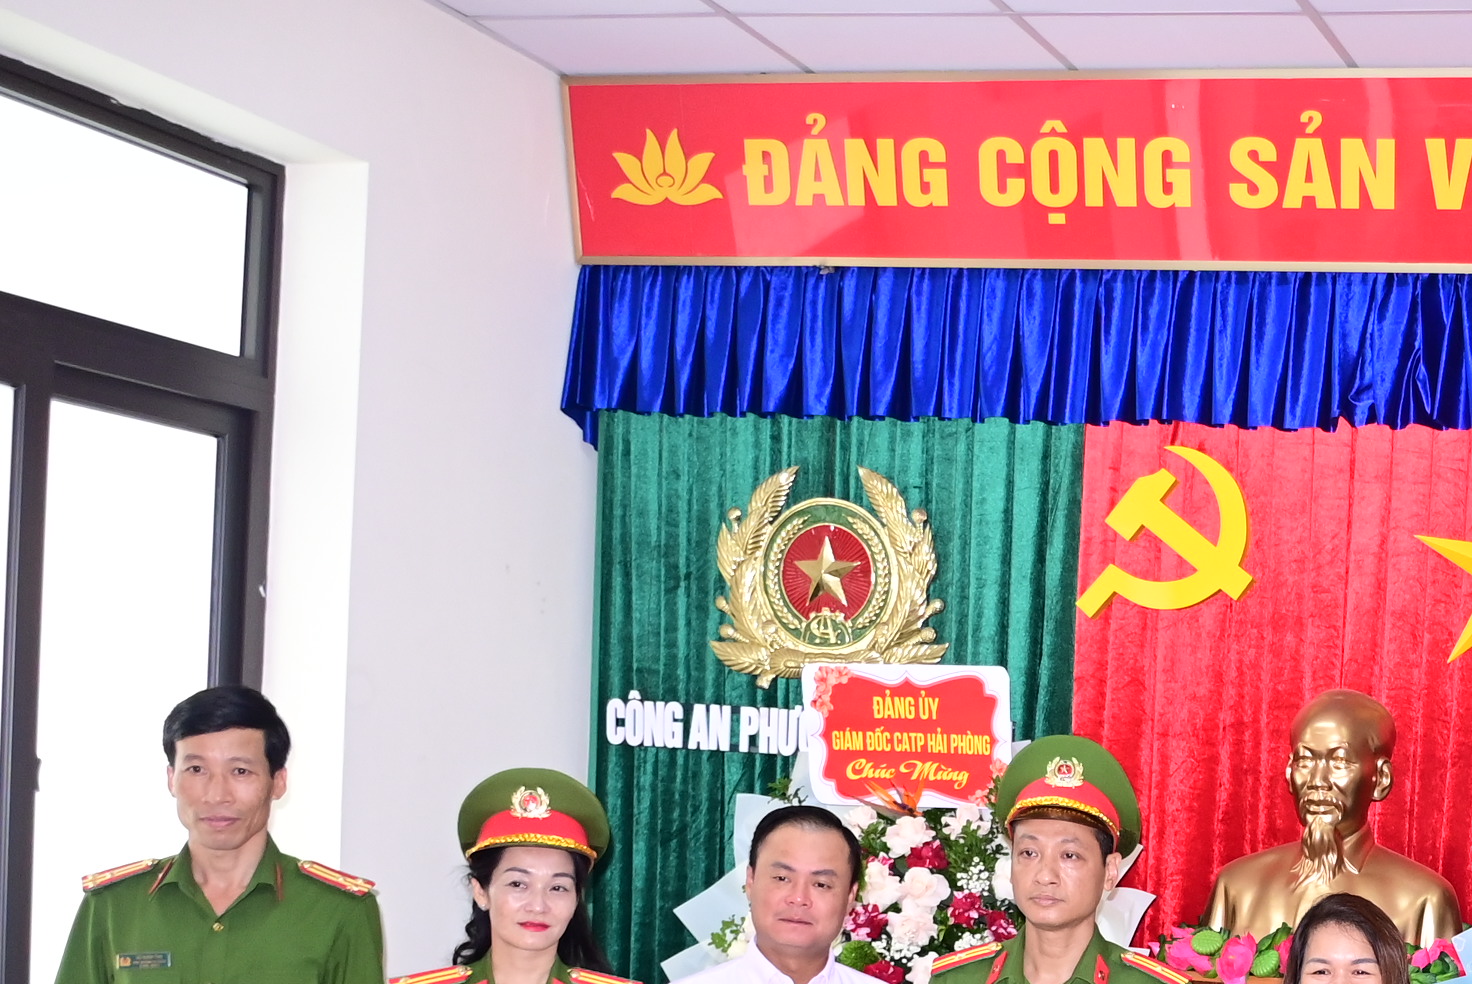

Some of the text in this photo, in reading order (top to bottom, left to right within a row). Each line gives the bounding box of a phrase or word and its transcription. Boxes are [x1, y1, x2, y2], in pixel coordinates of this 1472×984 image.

[743, 113, 950, 208] ĐẢNG
[978, 120, 1192, 225] CỘNG
[1228, 110, 1396, 210] SẢN
[873, 689, 940, 720] ĐẢNG ỦY
[605, 690, 685, 751] CÔNG
[688, 703, 732, 752] AN
[831, 726, 991, 756] GIÁM ĐỐC CATP HẢI PHÒNG
[846, 758, 970, 790] Chúc Mừng
